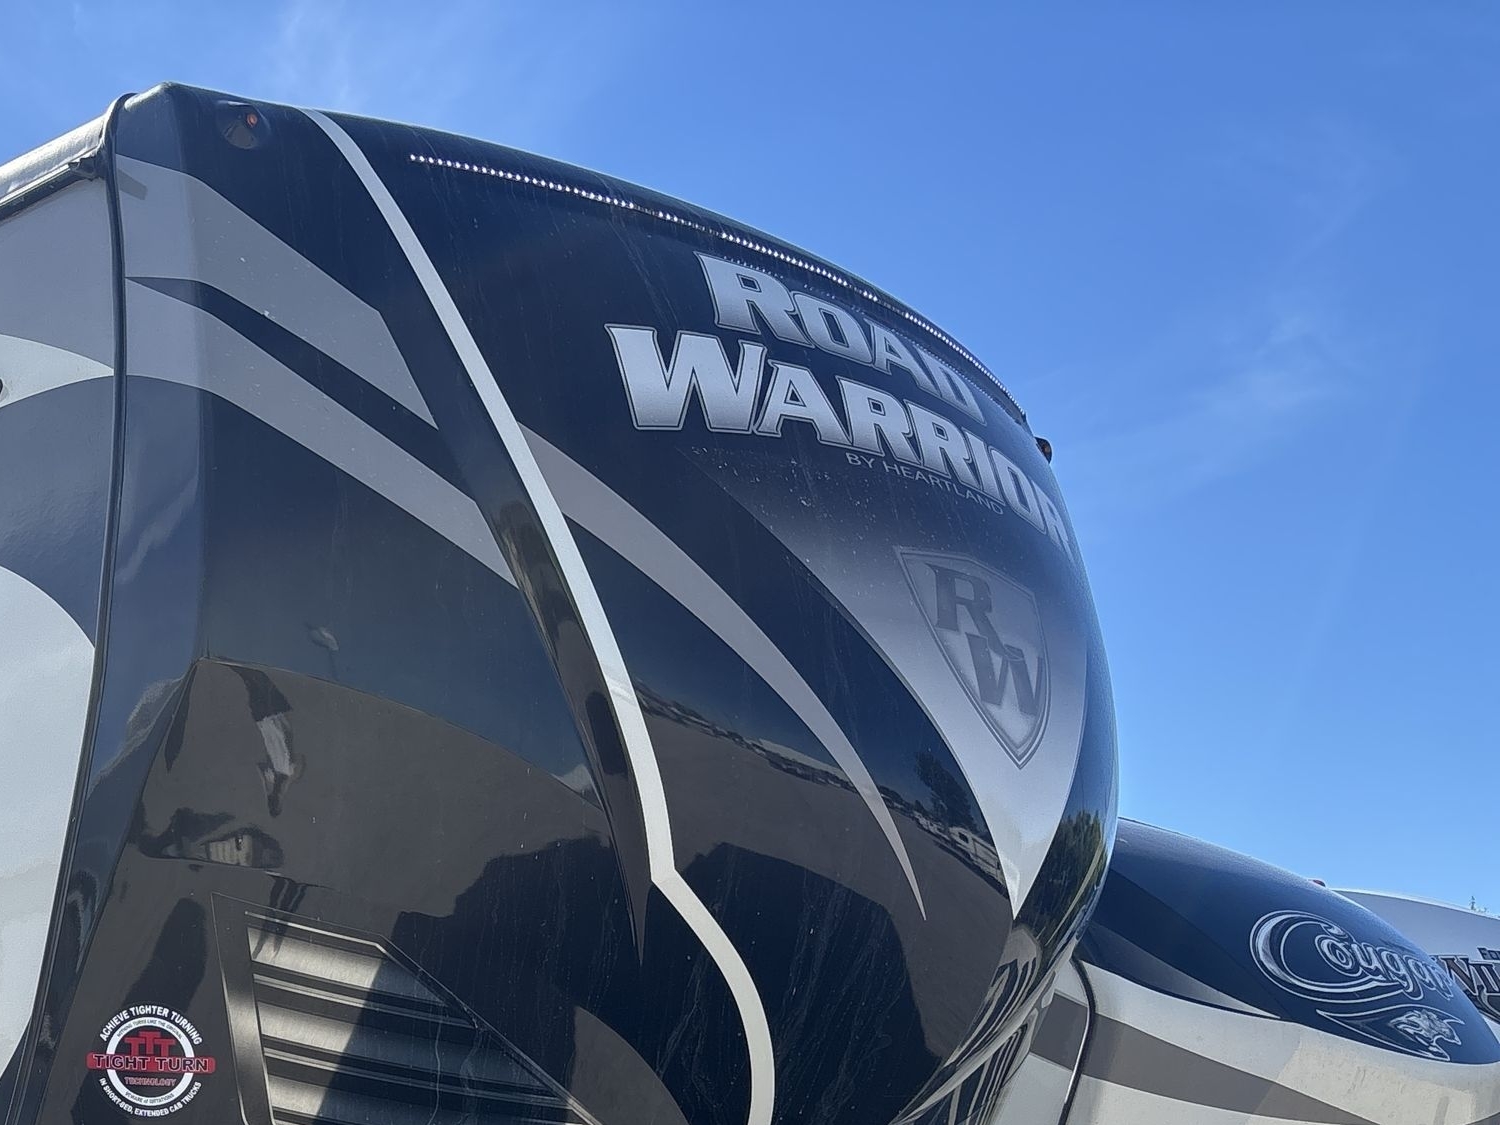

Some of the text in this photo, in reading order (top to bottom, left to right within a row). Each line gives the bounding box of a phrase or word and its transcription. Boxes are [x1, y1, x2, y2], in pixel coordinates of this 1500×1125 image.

[693, 250, 987, 426] ROAD
[604, 323, 1077, 564] WARRIOR
[845, 452, 1004, 515] BY HEARTLAND
[1249, 910, 1455, 1004] Cougar
[100, 1005, 203, 1045] ACHIEVE TIGHTER TURNING
[93, 1054, 209, 1072] TIGHT TURN
[124, 1076, 177, 1087] TECHNOLOGY
[100, 1078, 202, 1117] IN SHORT-BED, EXTENDED CAB TRUCKS
